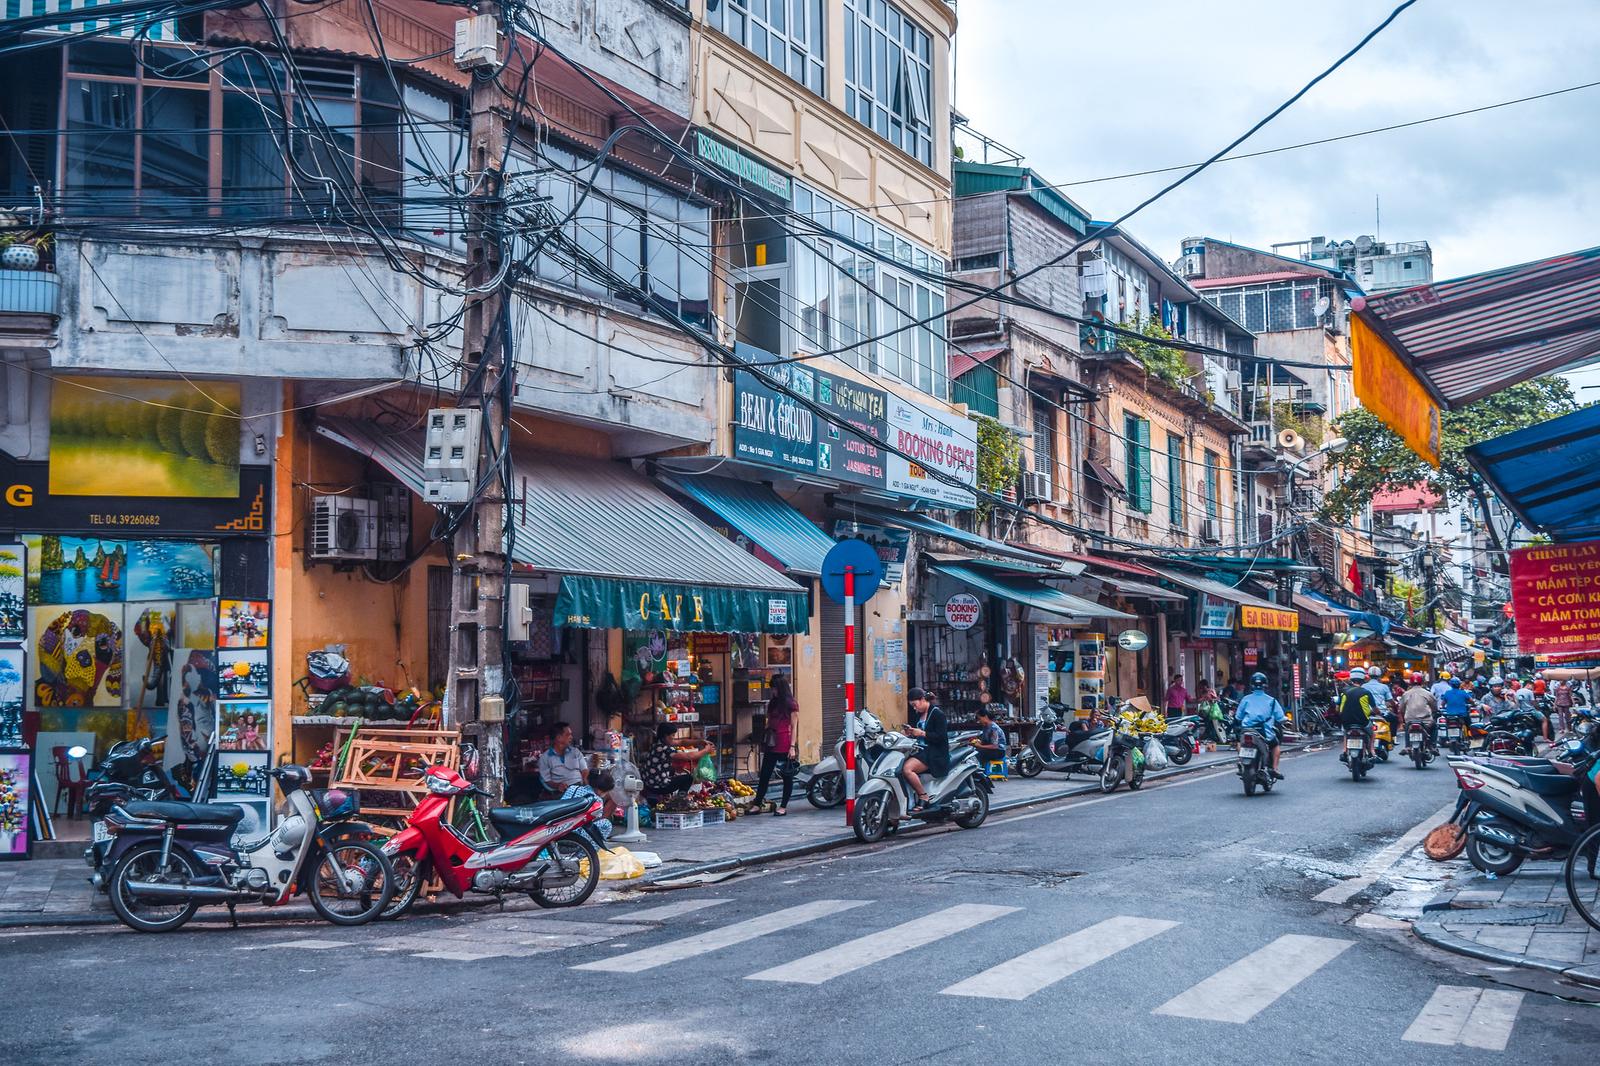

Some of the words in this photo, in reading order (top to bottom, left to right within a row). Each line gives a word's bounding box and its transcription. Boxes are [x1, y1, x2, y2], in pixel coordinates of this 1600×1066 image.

[868, 392, 884, 420] TEA
[741, 391, 766, 433] BEAN
[768, 399, 776, 436] &
[778, 403, 813, 445] GROUND
[922, 416, 933, 431] Mrs
[846, 440, 866, 455] LOTUS
[866, 444, 878, 459] TEA
[897, 430, 944, 465] BOOKING
[945, 443, 975, 474] OFFICE
[847, 459, 871, 476] JASMINE
[872, 465, 883, 479] TEA
[909, 463, 926, 478] TOUR
[105, 515, 160, 525] 04.39260682
[639, 592, 704, 623] CAFE
[947, 603, 978, 614] BOOKING
[951, 613, 973, 623] OFFICE
[1261, 611, 1275, 627] GIA
